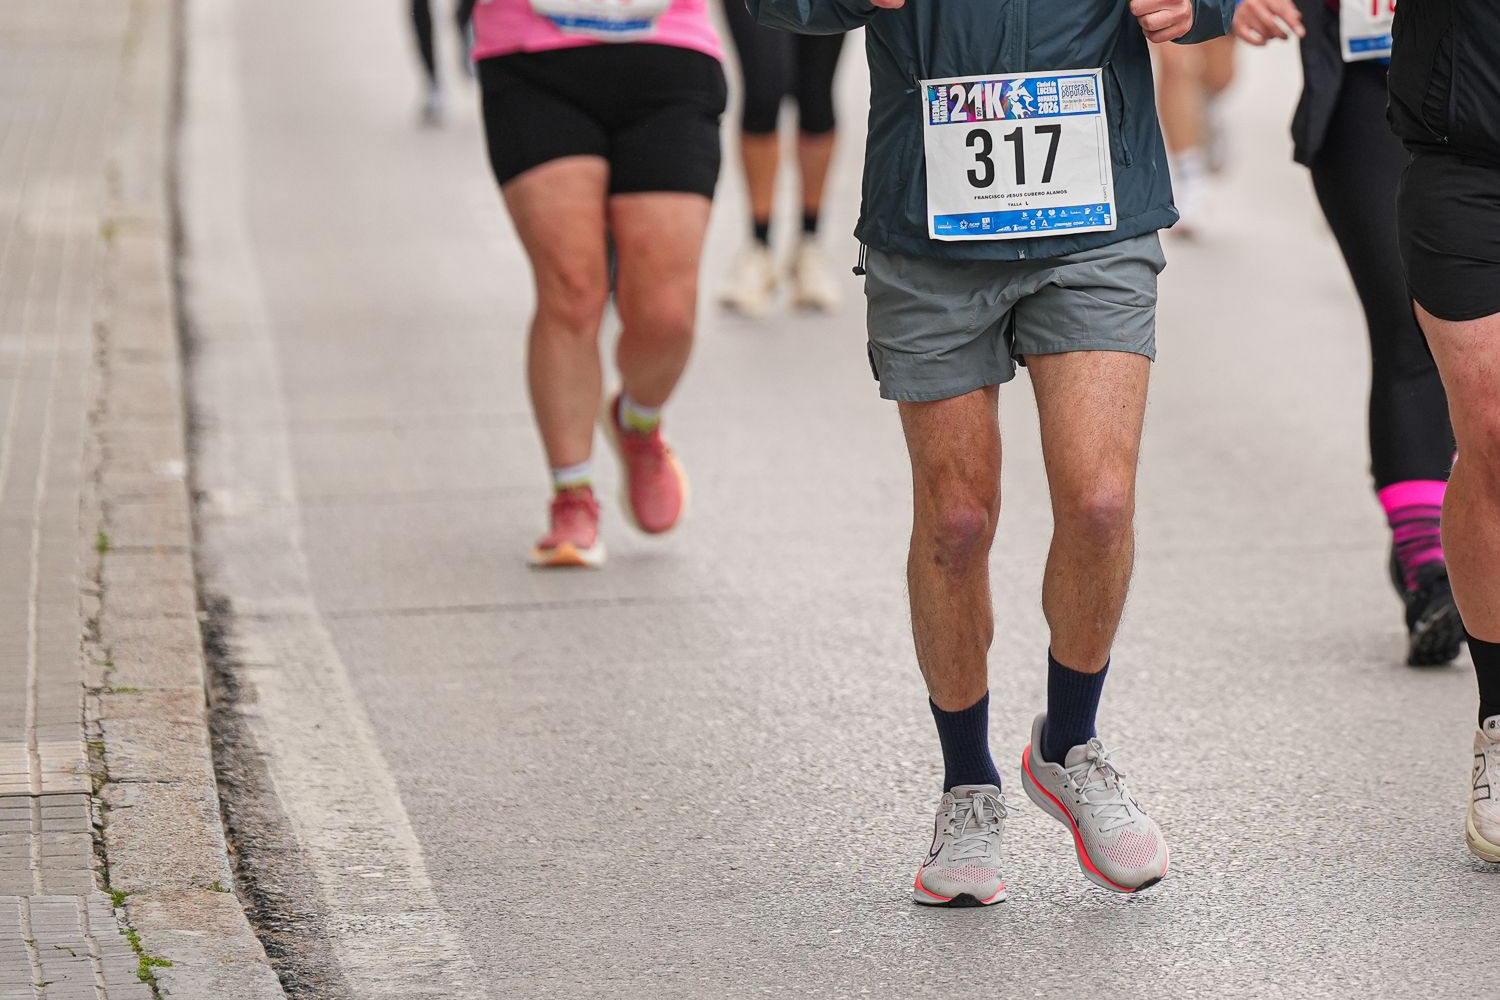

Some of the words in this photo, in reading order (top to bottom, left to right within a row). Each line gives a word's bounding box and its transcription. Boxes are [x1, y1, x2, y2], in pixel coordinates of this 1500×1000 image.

[1036, 87, 1057, 95] LUCENA
[1061, 83, 1089, 92] carreras
[1061, 88, 1095, 99] populares
[949, 83, 1006, 121] 21K
[1037, 102, 1059, 114] 2026
[965, 124, 1062, 189] 317
